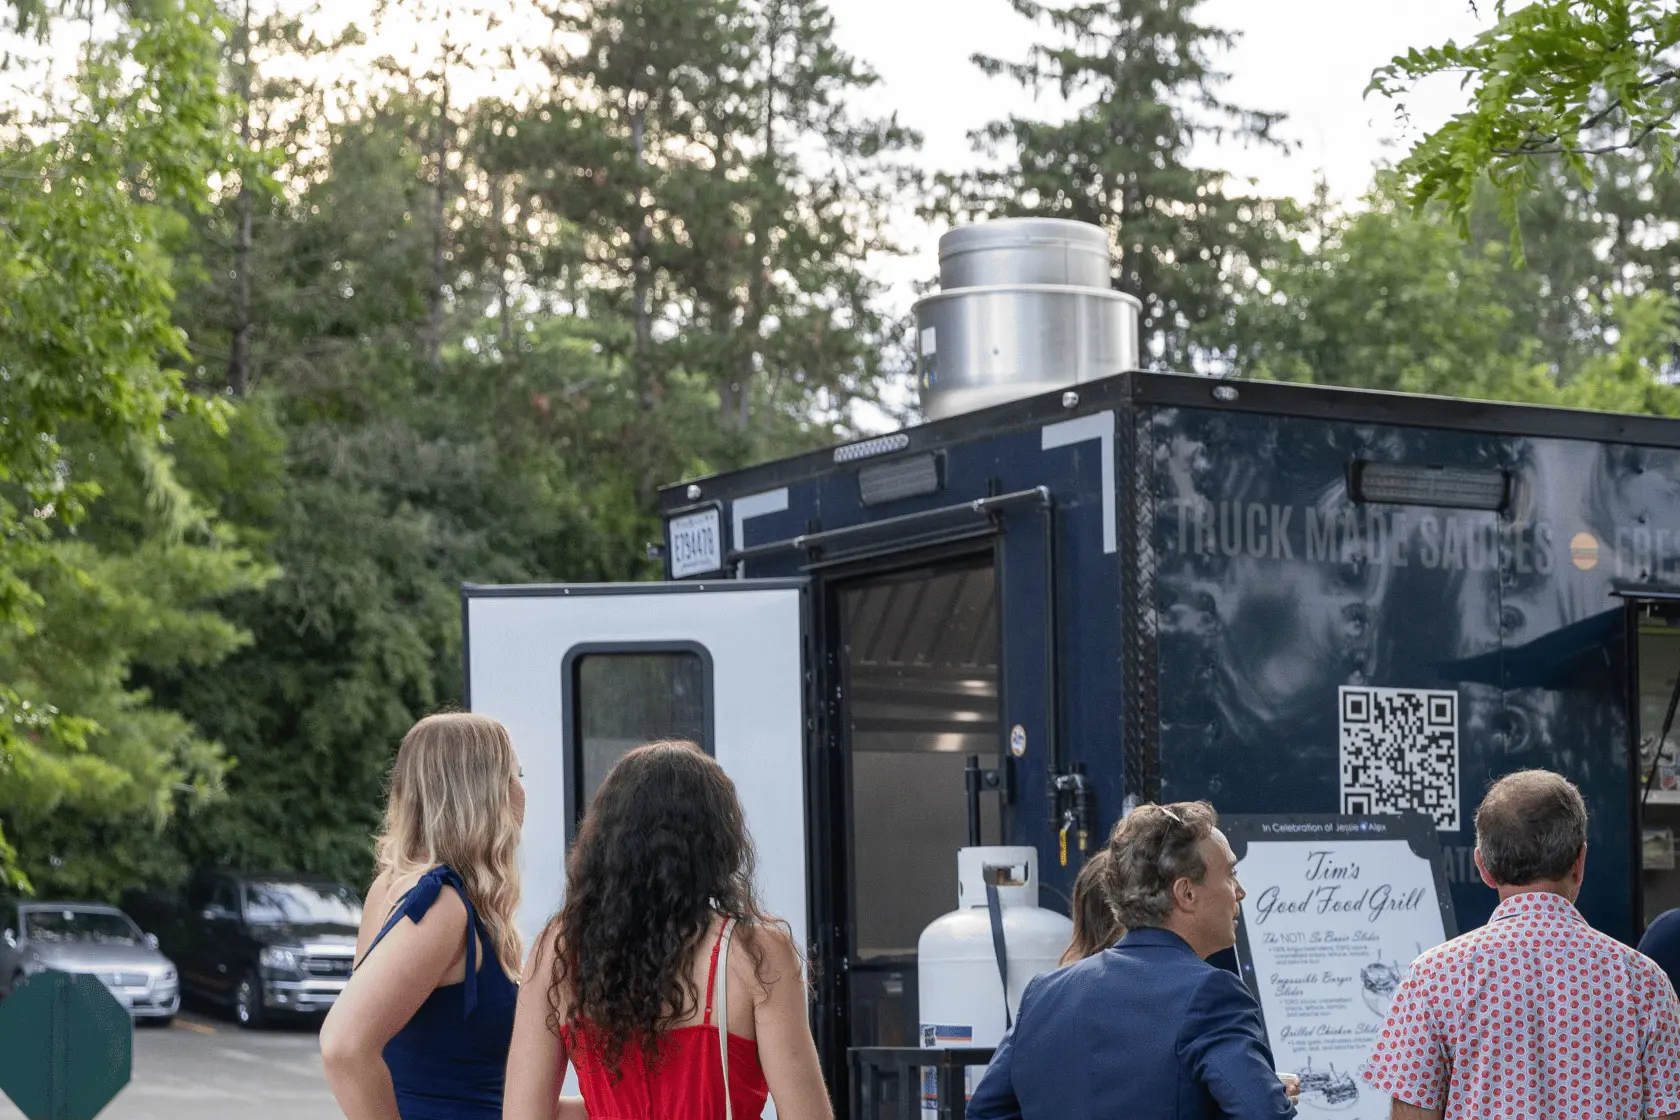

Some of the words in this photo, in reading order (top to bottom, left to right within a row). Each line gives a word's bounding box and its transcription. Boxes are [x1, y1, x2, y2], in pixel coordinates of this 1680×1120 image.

[1175, 498, 1295, 561] TRUCK
[1305, 505, 1409, 567] MADE
[1419, 515, 1554, 576] SAUCES
[1262, 823, 1271, 833] In
[1272, 823, 1323, 833] Celebration
[1324, 823, 1333, 832] of
[1305, 850, 1360, 881] Tim's
[1256, 885, 1315, 925] Good
[1315, 884, 1369, 915] Food
[1368, 883, 1427, 923] Grill
[1280, 1025, 1316, 1042] Grilled
